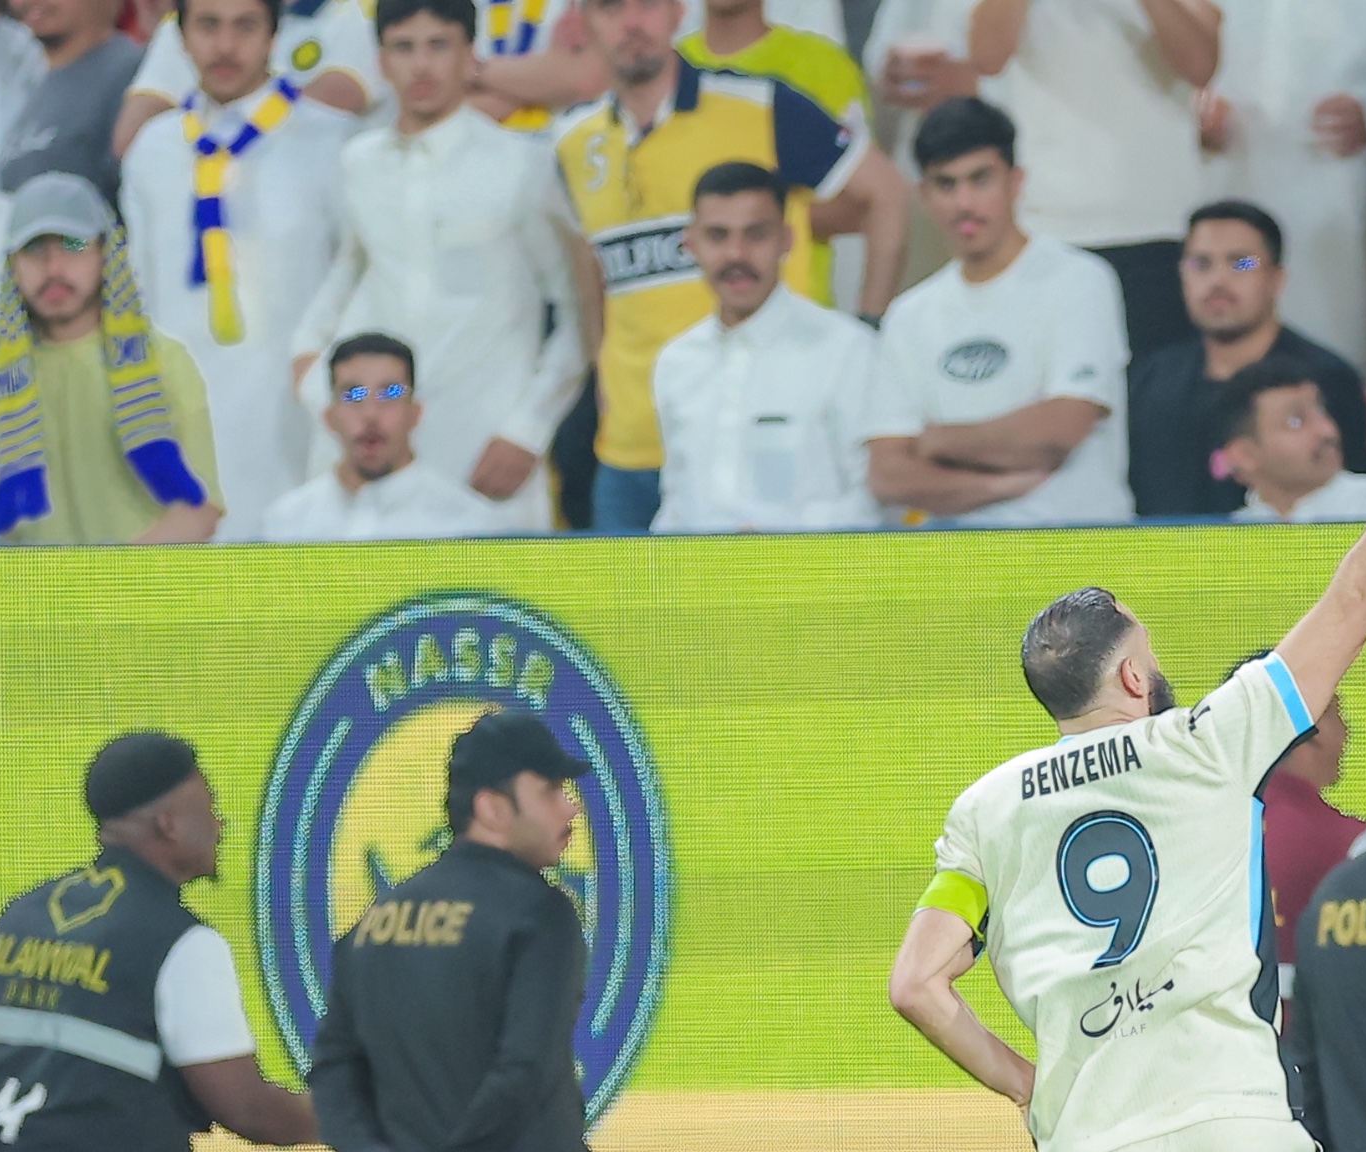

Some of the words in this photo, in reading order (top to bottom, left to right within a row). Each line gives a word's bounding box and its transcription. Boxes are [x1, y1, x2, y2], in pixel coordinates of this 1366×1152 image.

[362, 627, 555, 713] NASSR
[1021, 735, 1142, 800] BENZEMA
[1055, 809, 1160, 970] 9
[353, 899, 475, 948] POLICE
[1113, 1022, 1148, 1040] ILAF
